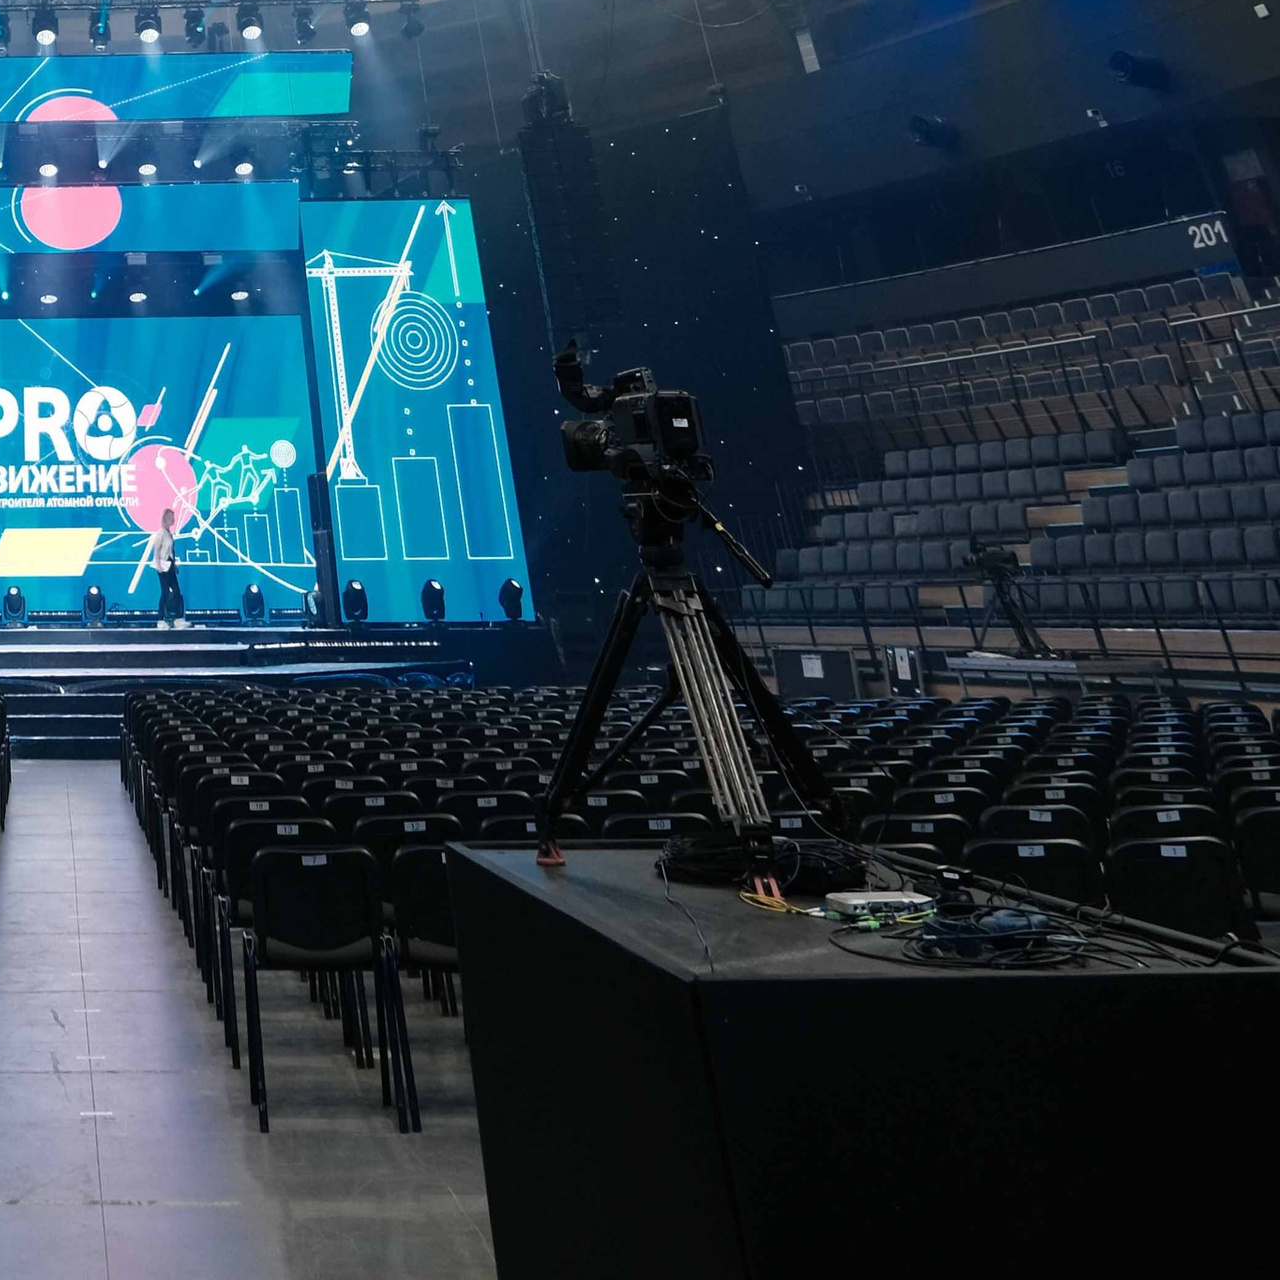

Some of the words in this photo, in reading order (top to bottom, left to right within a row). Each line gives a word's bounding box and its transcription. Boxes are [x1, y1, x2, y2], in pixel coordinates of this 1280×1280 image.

[1188, 221, 1228, 248] 201
[47, 495, 94, 508] АТОМНОЙ
[95, 496, 138, 507] ОТРАСЛИ
[411, 822, 420, 831] 12
[655, 821, 665, 829] 10
[284, 826, 293, 834] 13
